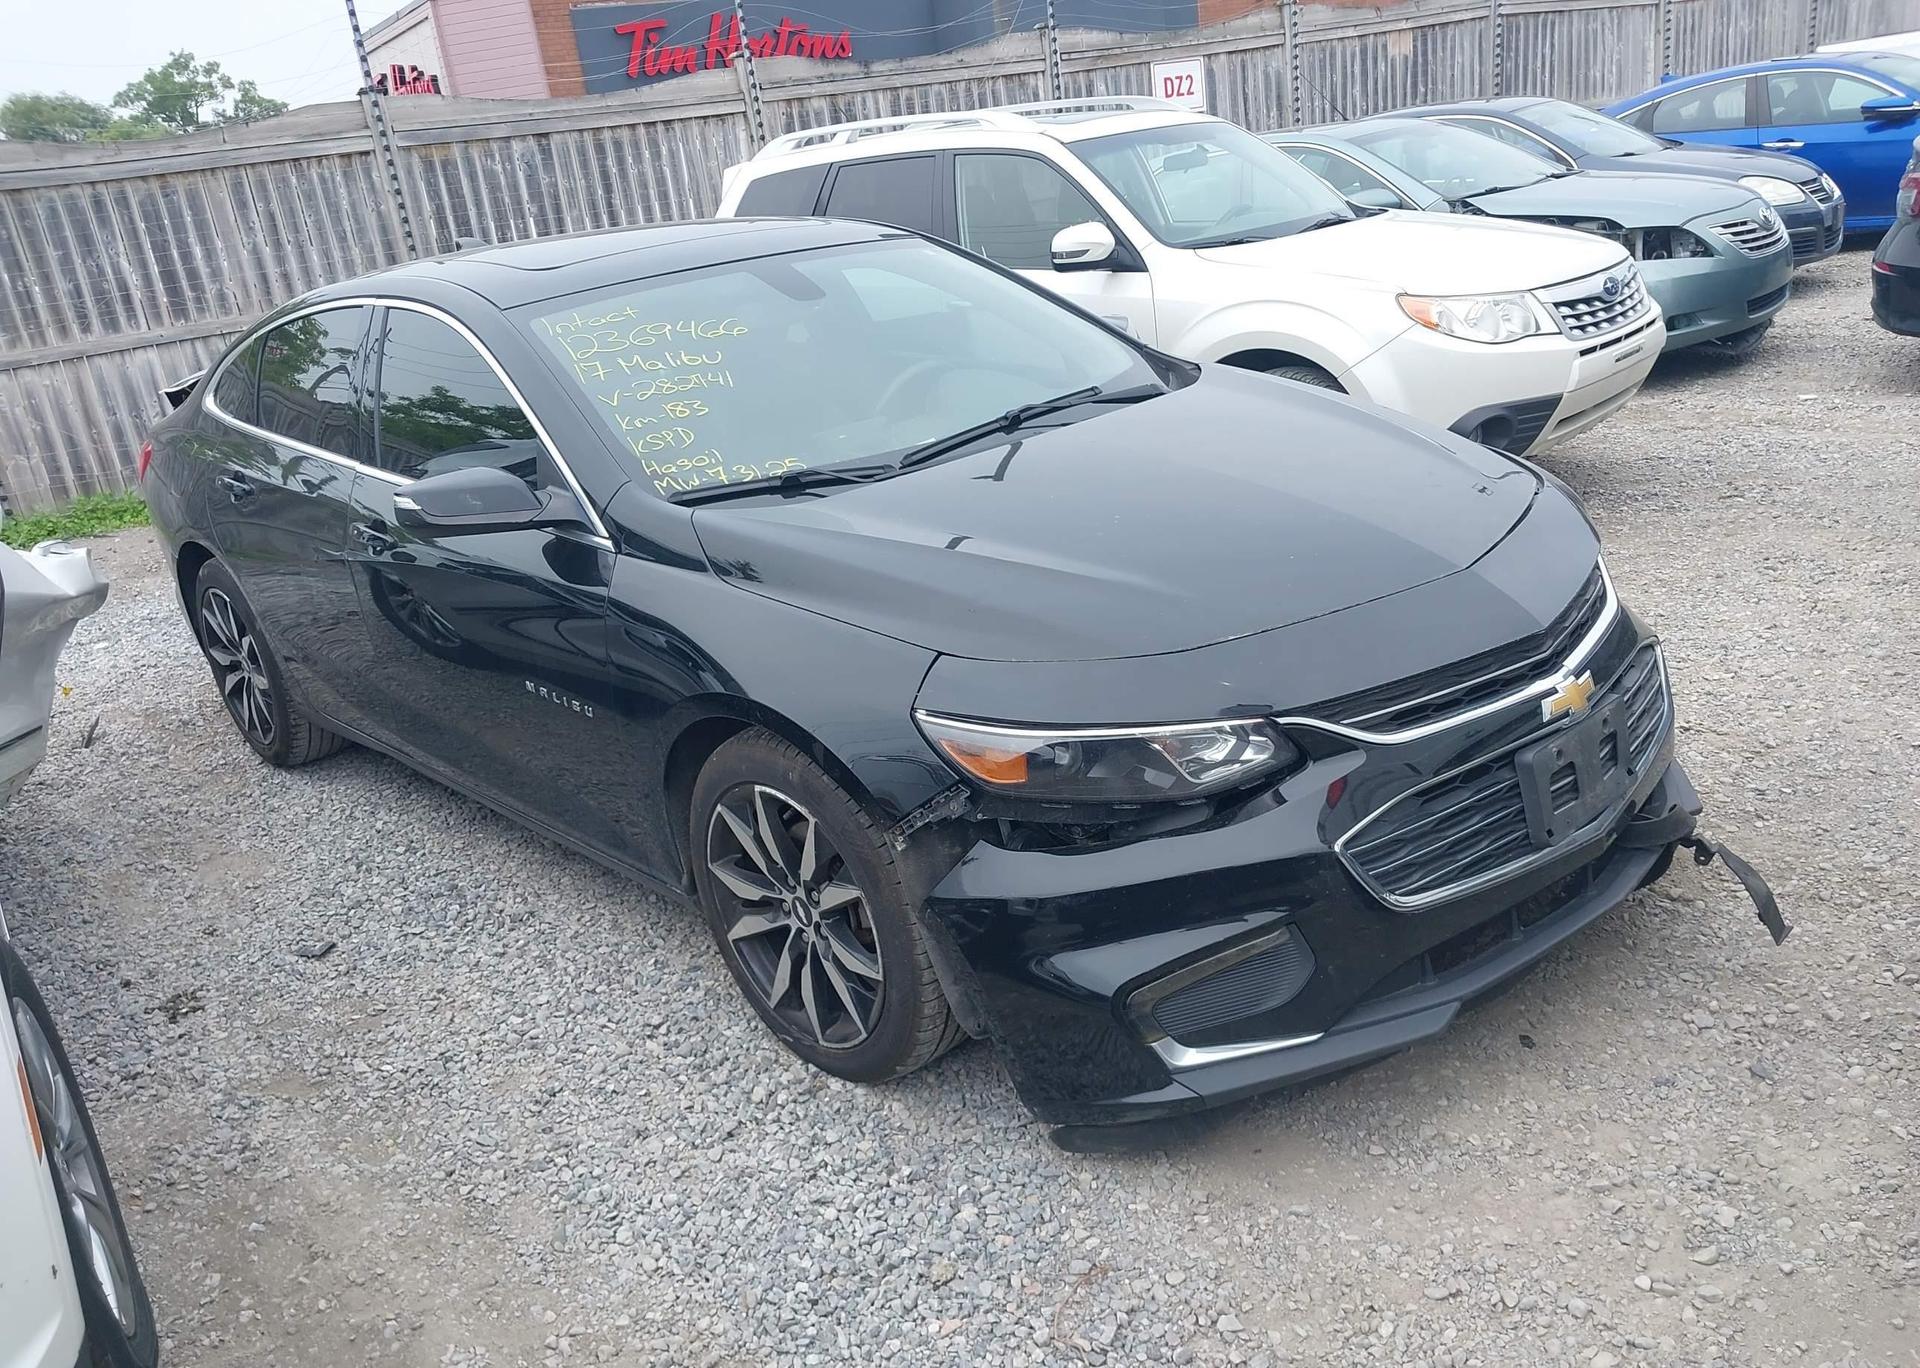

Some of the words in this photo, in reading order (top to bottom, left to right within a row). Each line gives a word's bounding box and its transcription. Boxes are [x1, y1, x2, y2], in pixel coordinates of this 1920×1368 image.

[614, 19, 698, 78] Tim
[1163, 74, 1195, 98] DZ2
[540, 306, 640, 336] Intact
[557, 318, 748, 361] 12369466
[573, 362, 613, 385] 17
[617, 350, 722, 375] Malibu
[525, 680, 593, 718] MALIBU
